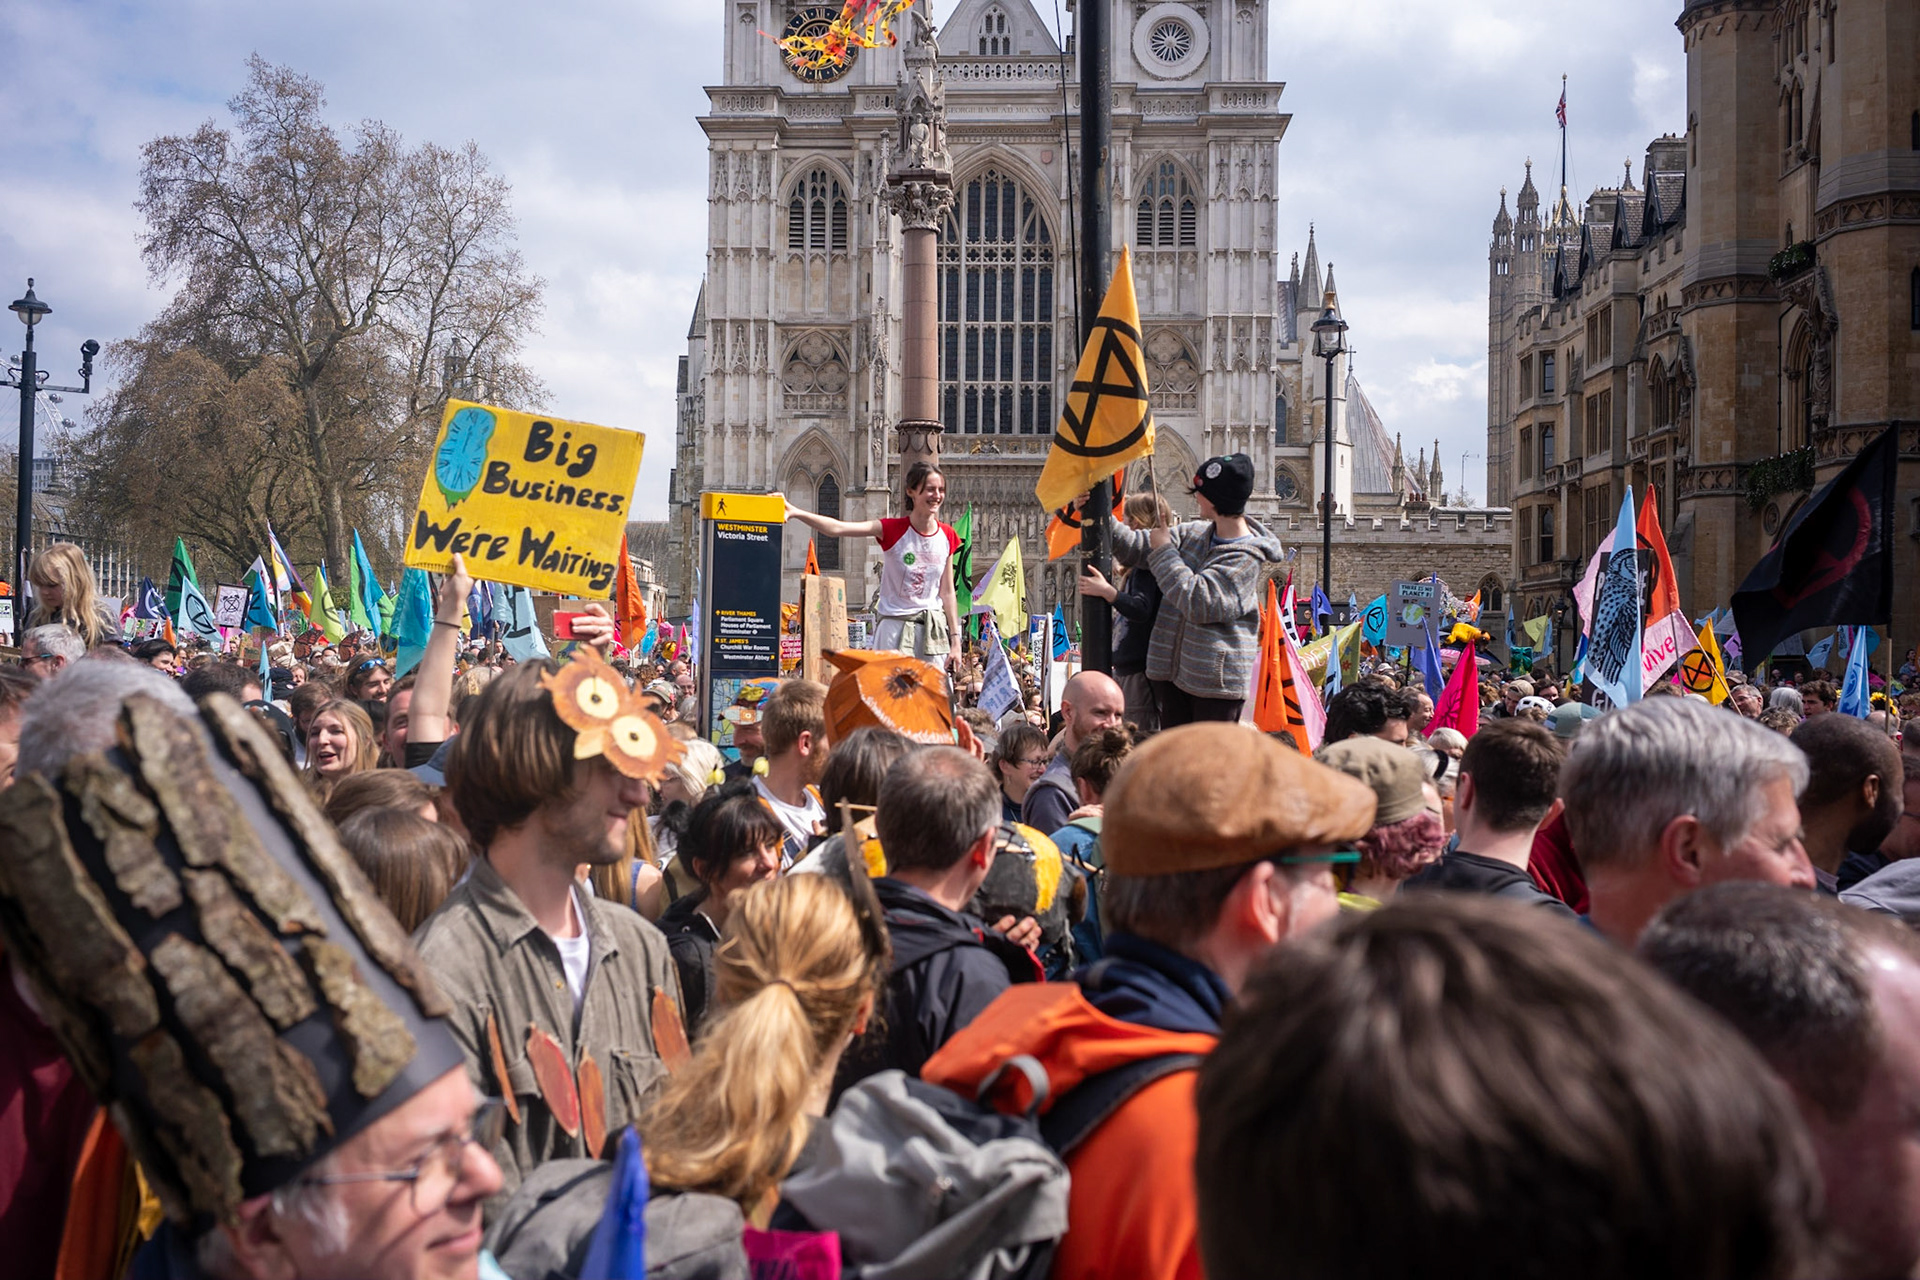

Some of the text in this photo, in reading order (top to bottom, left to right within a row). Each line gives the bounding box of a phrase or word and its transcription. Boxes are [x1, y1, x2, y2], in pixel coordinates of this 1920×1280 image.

[523, 420, 597, 478] Big
[482, 461, 625, 516] Business,
[717, 523, 768, 533] WESTMINSTER
[717, 531, 768, 541] Victoria Street
[1642, 636, 1676, 678] vive
